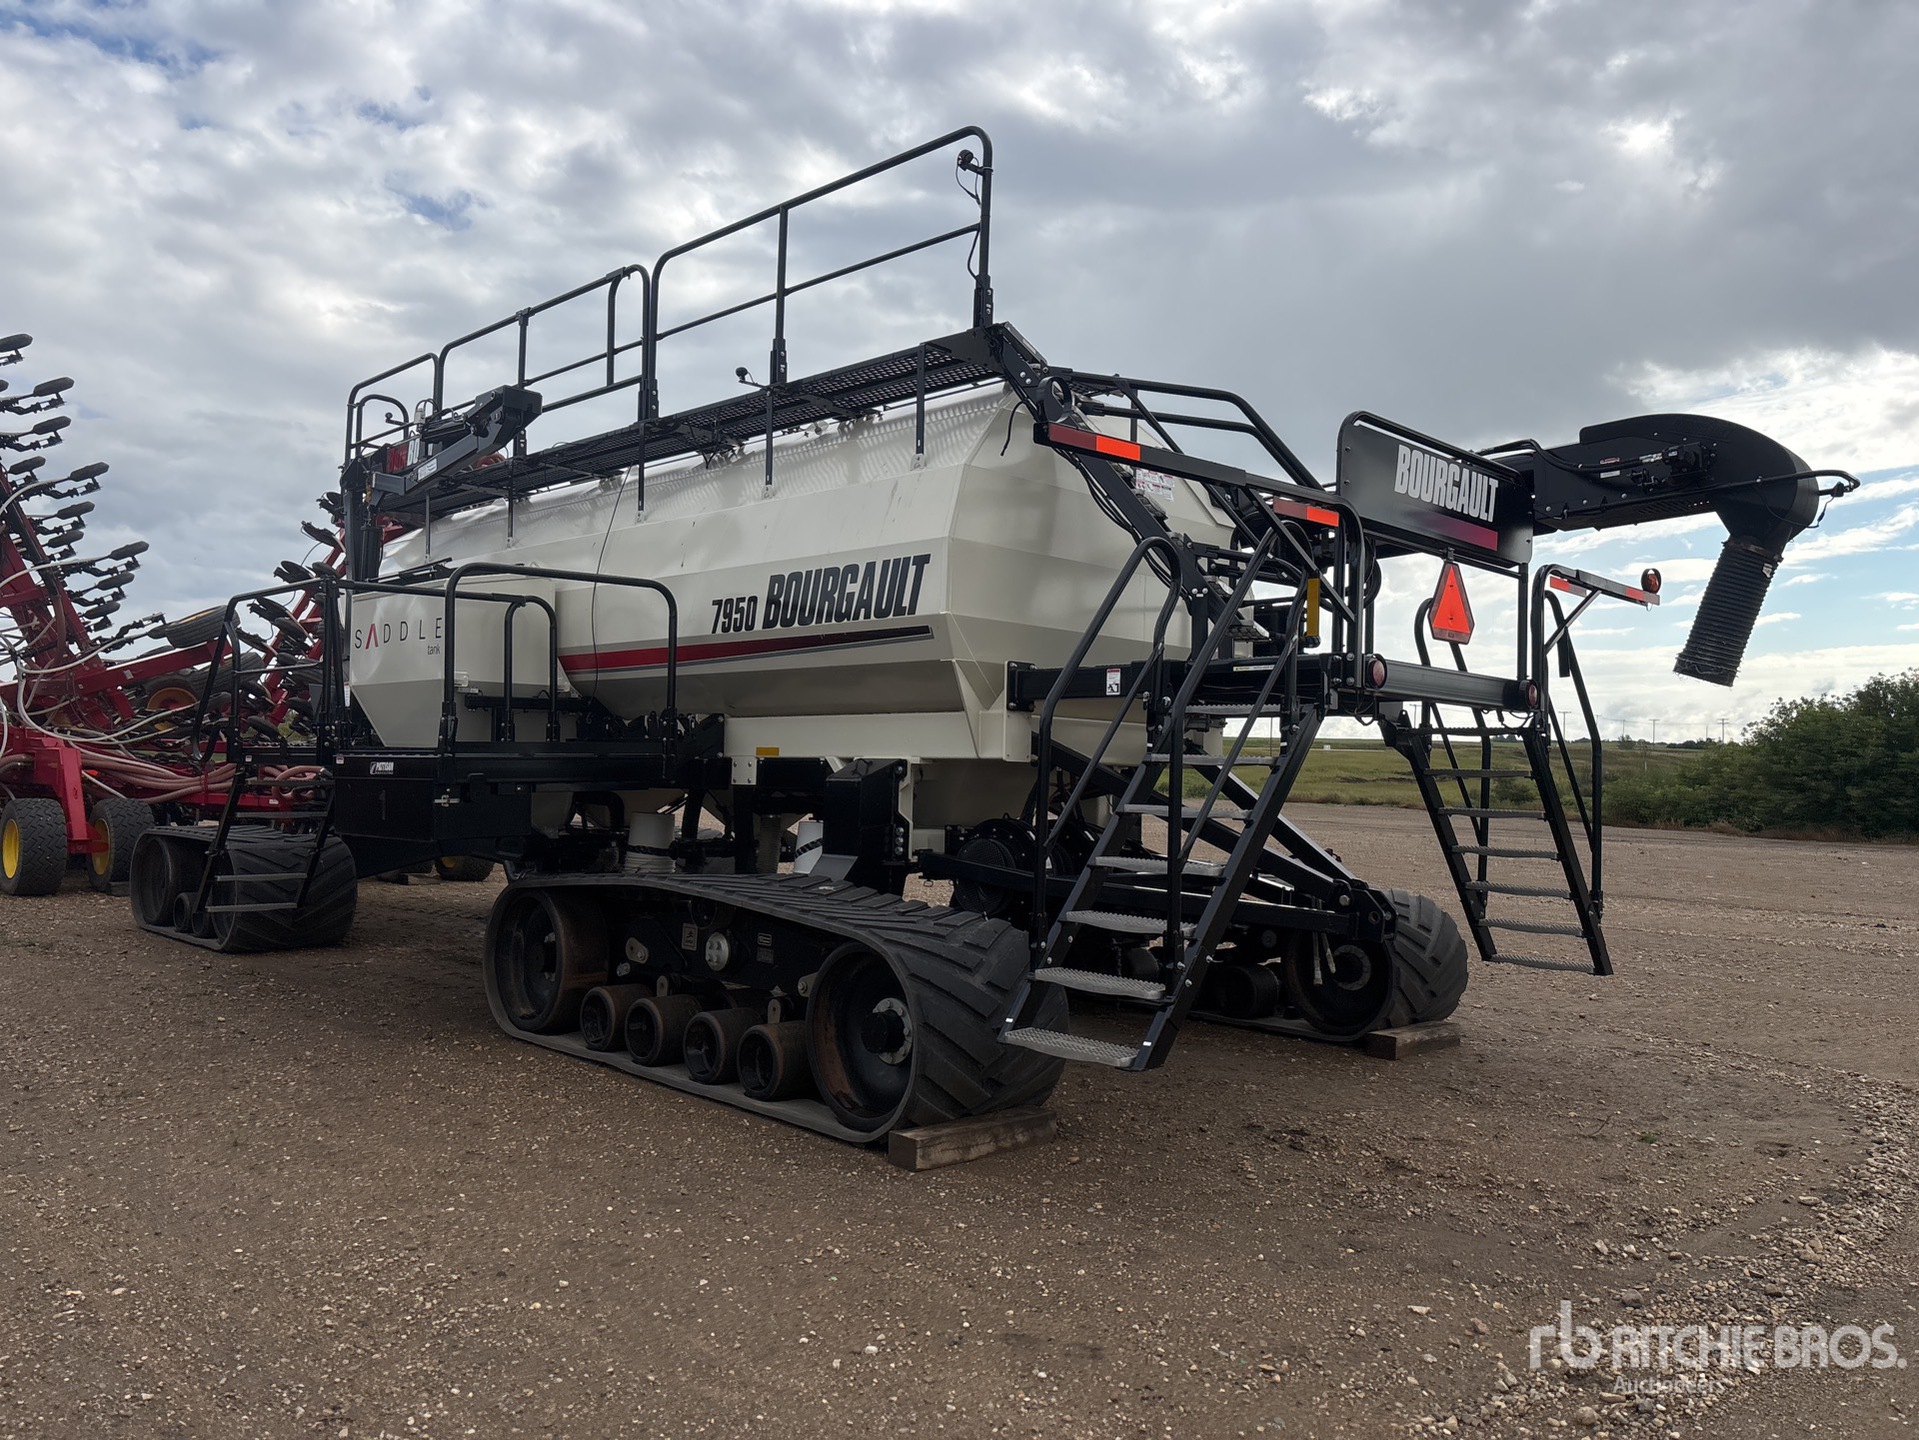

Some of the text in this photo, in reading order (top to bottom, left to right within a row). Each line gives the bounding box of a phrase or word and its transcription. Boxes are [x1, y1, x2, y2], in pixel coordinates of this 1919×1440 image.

[1394, 444, 1499, 523] BOURGAULT
[711, 553, 931, 634] 7950 BOURGAULT
[354, 617, 442, 650] SADDLE
[427, 643, 441, 655] tank
